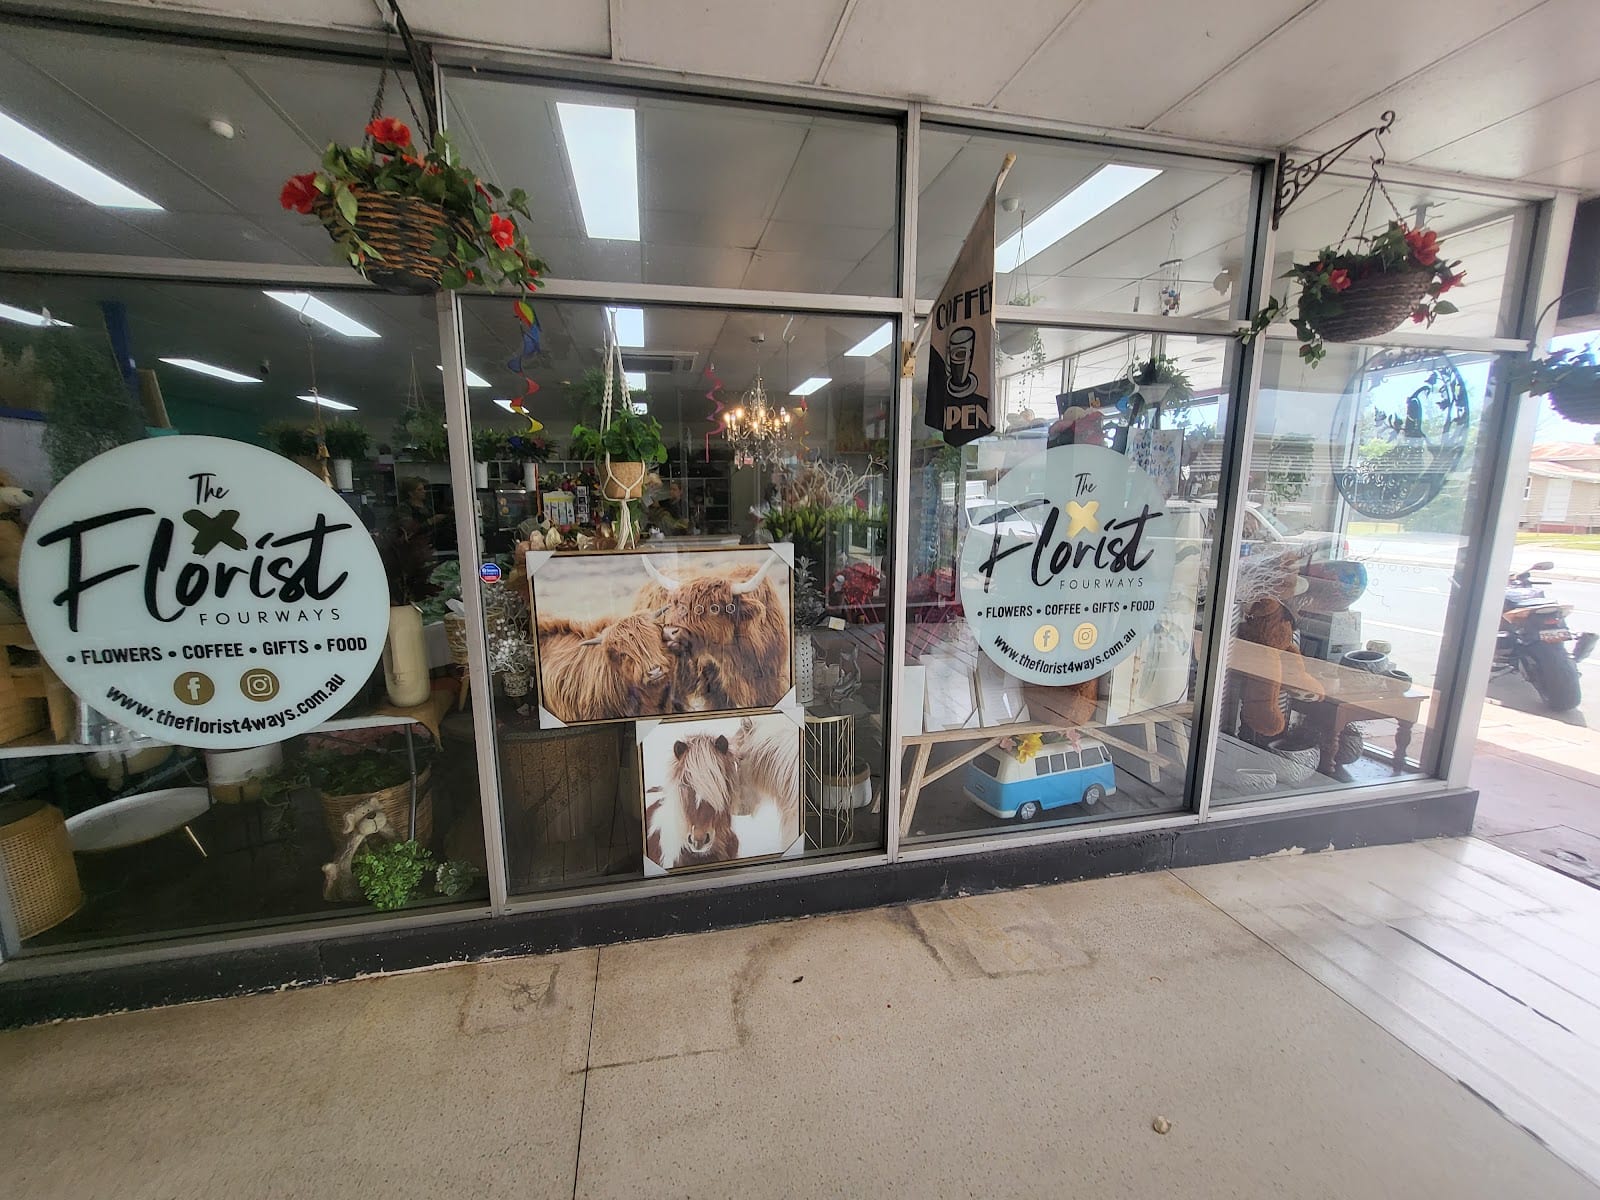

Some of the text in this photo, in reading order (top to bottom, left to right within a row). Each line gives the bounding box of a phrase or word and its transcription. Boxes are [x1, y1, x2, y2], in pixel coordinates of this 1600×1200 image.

[943, 404, 991, 431] PEN
[188, 472, 231, 505] The
[1074, 472, 1097, 497] The
[978, 498, 1164, 594] Florist
[37, 507, 353, 633] Florist
[1059, 577, 1144, 590] FOURWAYS
[199, 608, 341, 626] FOURWAYS
[986, 599, 1155, 619] FLOWERS COFFEE GIFTS FOOD
[81, 637, 368, 665] FLOWERS COFFEE GIFTS FOOD
[993, 627, 1137, 675] www.theflorist4ways.com.au
[105, 673, 347, 734] www.theflorist4ways.com.au
